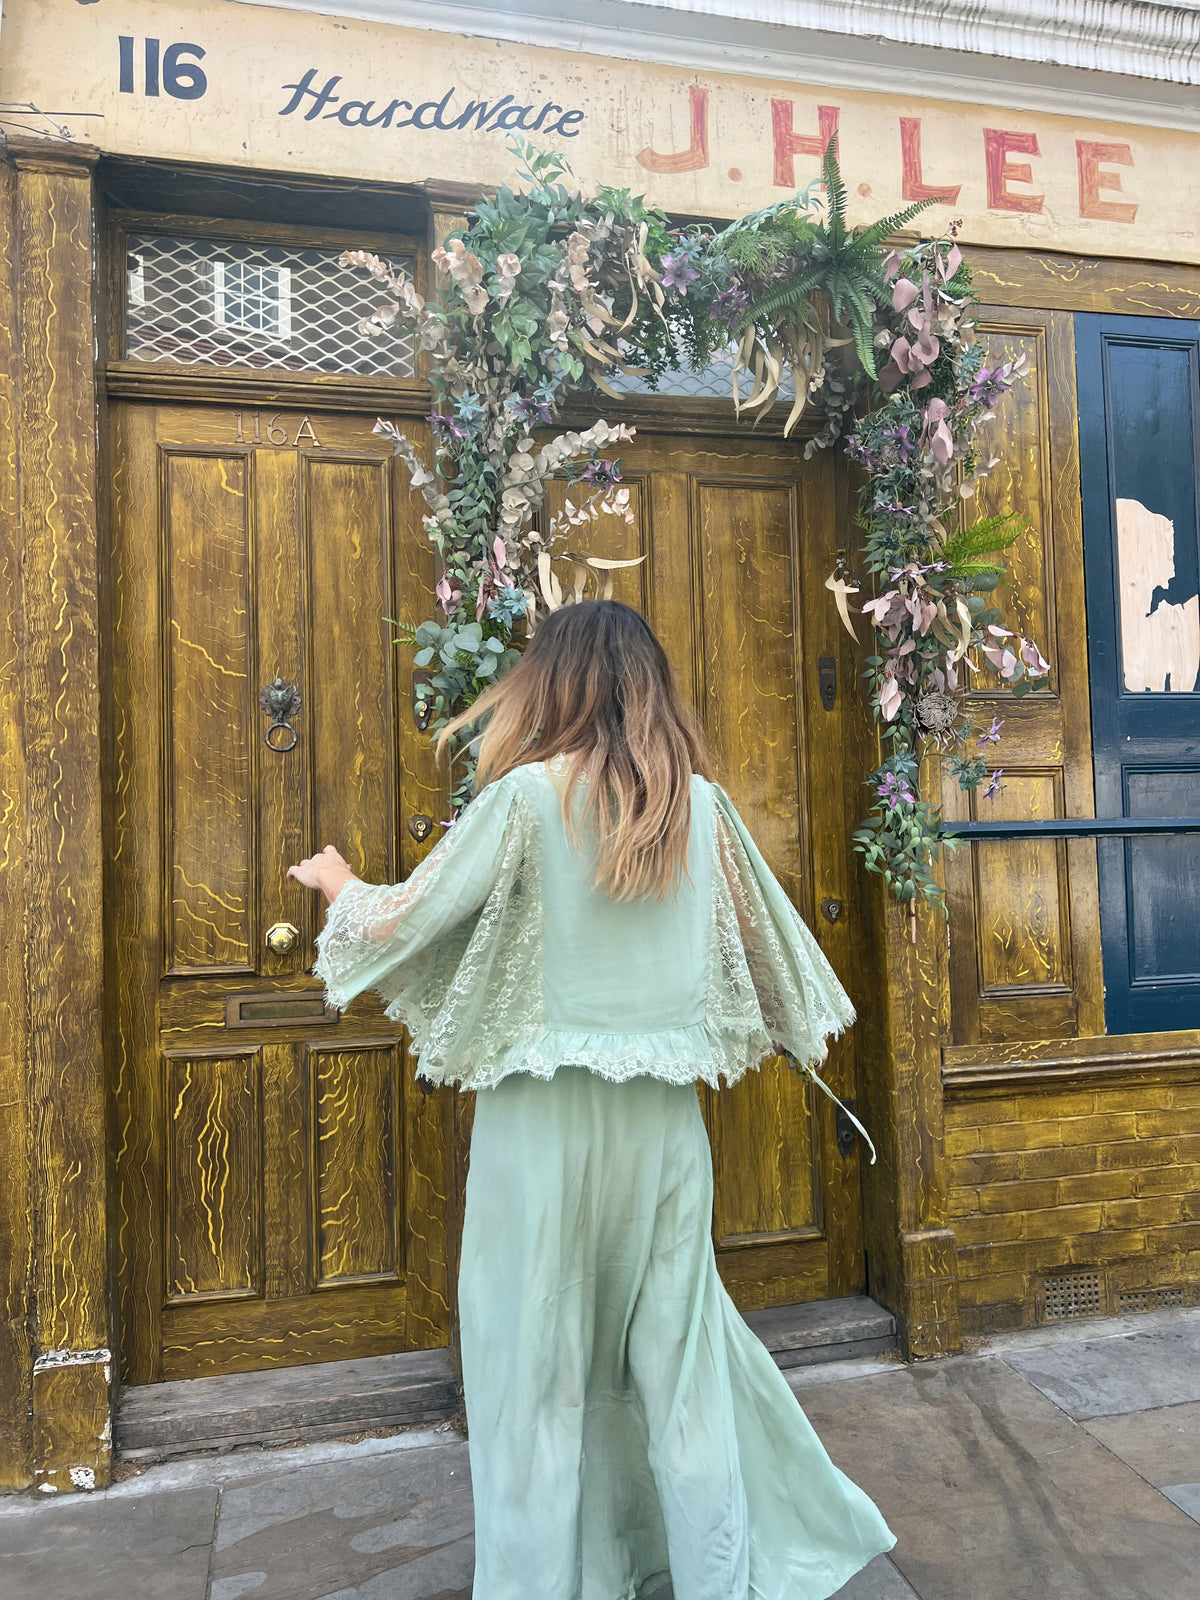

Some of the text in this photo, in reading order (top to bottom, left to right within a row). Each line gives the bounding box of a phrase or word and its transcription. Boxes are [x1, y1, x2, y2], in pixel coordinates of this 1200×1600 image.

[118, 35, 207, 100] 116
[278, 68, 585, 138] Hardware
[234, 411, 322, 447] 116A
